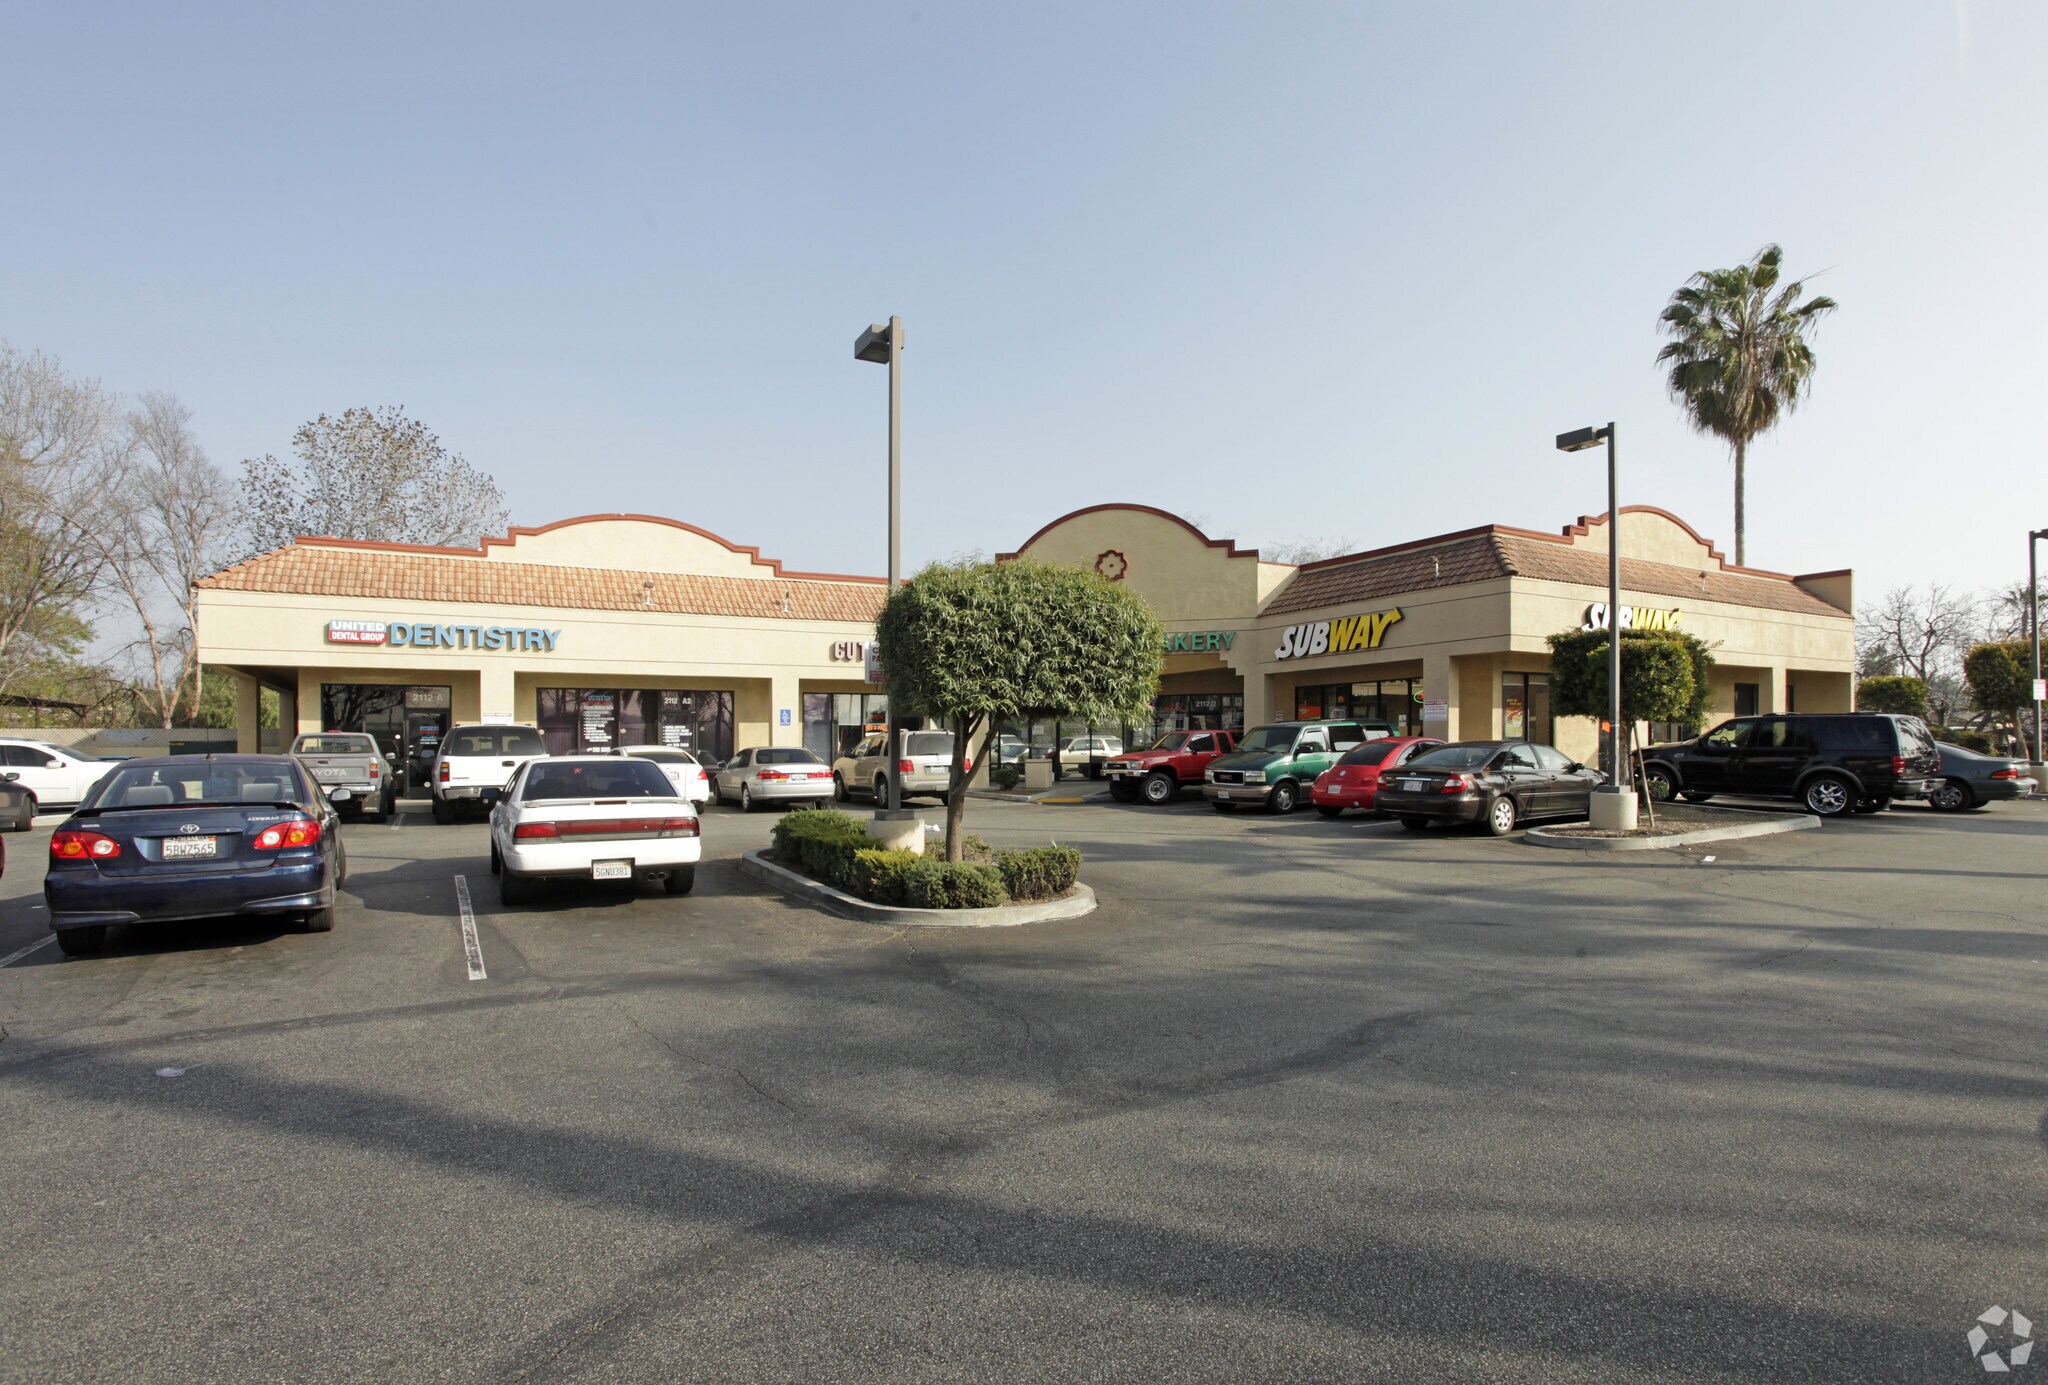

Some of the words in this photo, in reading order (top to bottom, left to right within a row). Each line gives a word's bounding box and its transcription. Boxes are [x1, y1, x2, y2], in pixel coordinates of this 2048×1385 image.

[331, 621, 386, 632] UNITED
[331, 632, 359, 641] DENTAL
[360, 633, 386, 642] GROUP
[390, 622, 562, 650] DENTISTRY
[1274, 607, 1402, 660] SUBWAY
[412, 693, 433, 702] 2112
